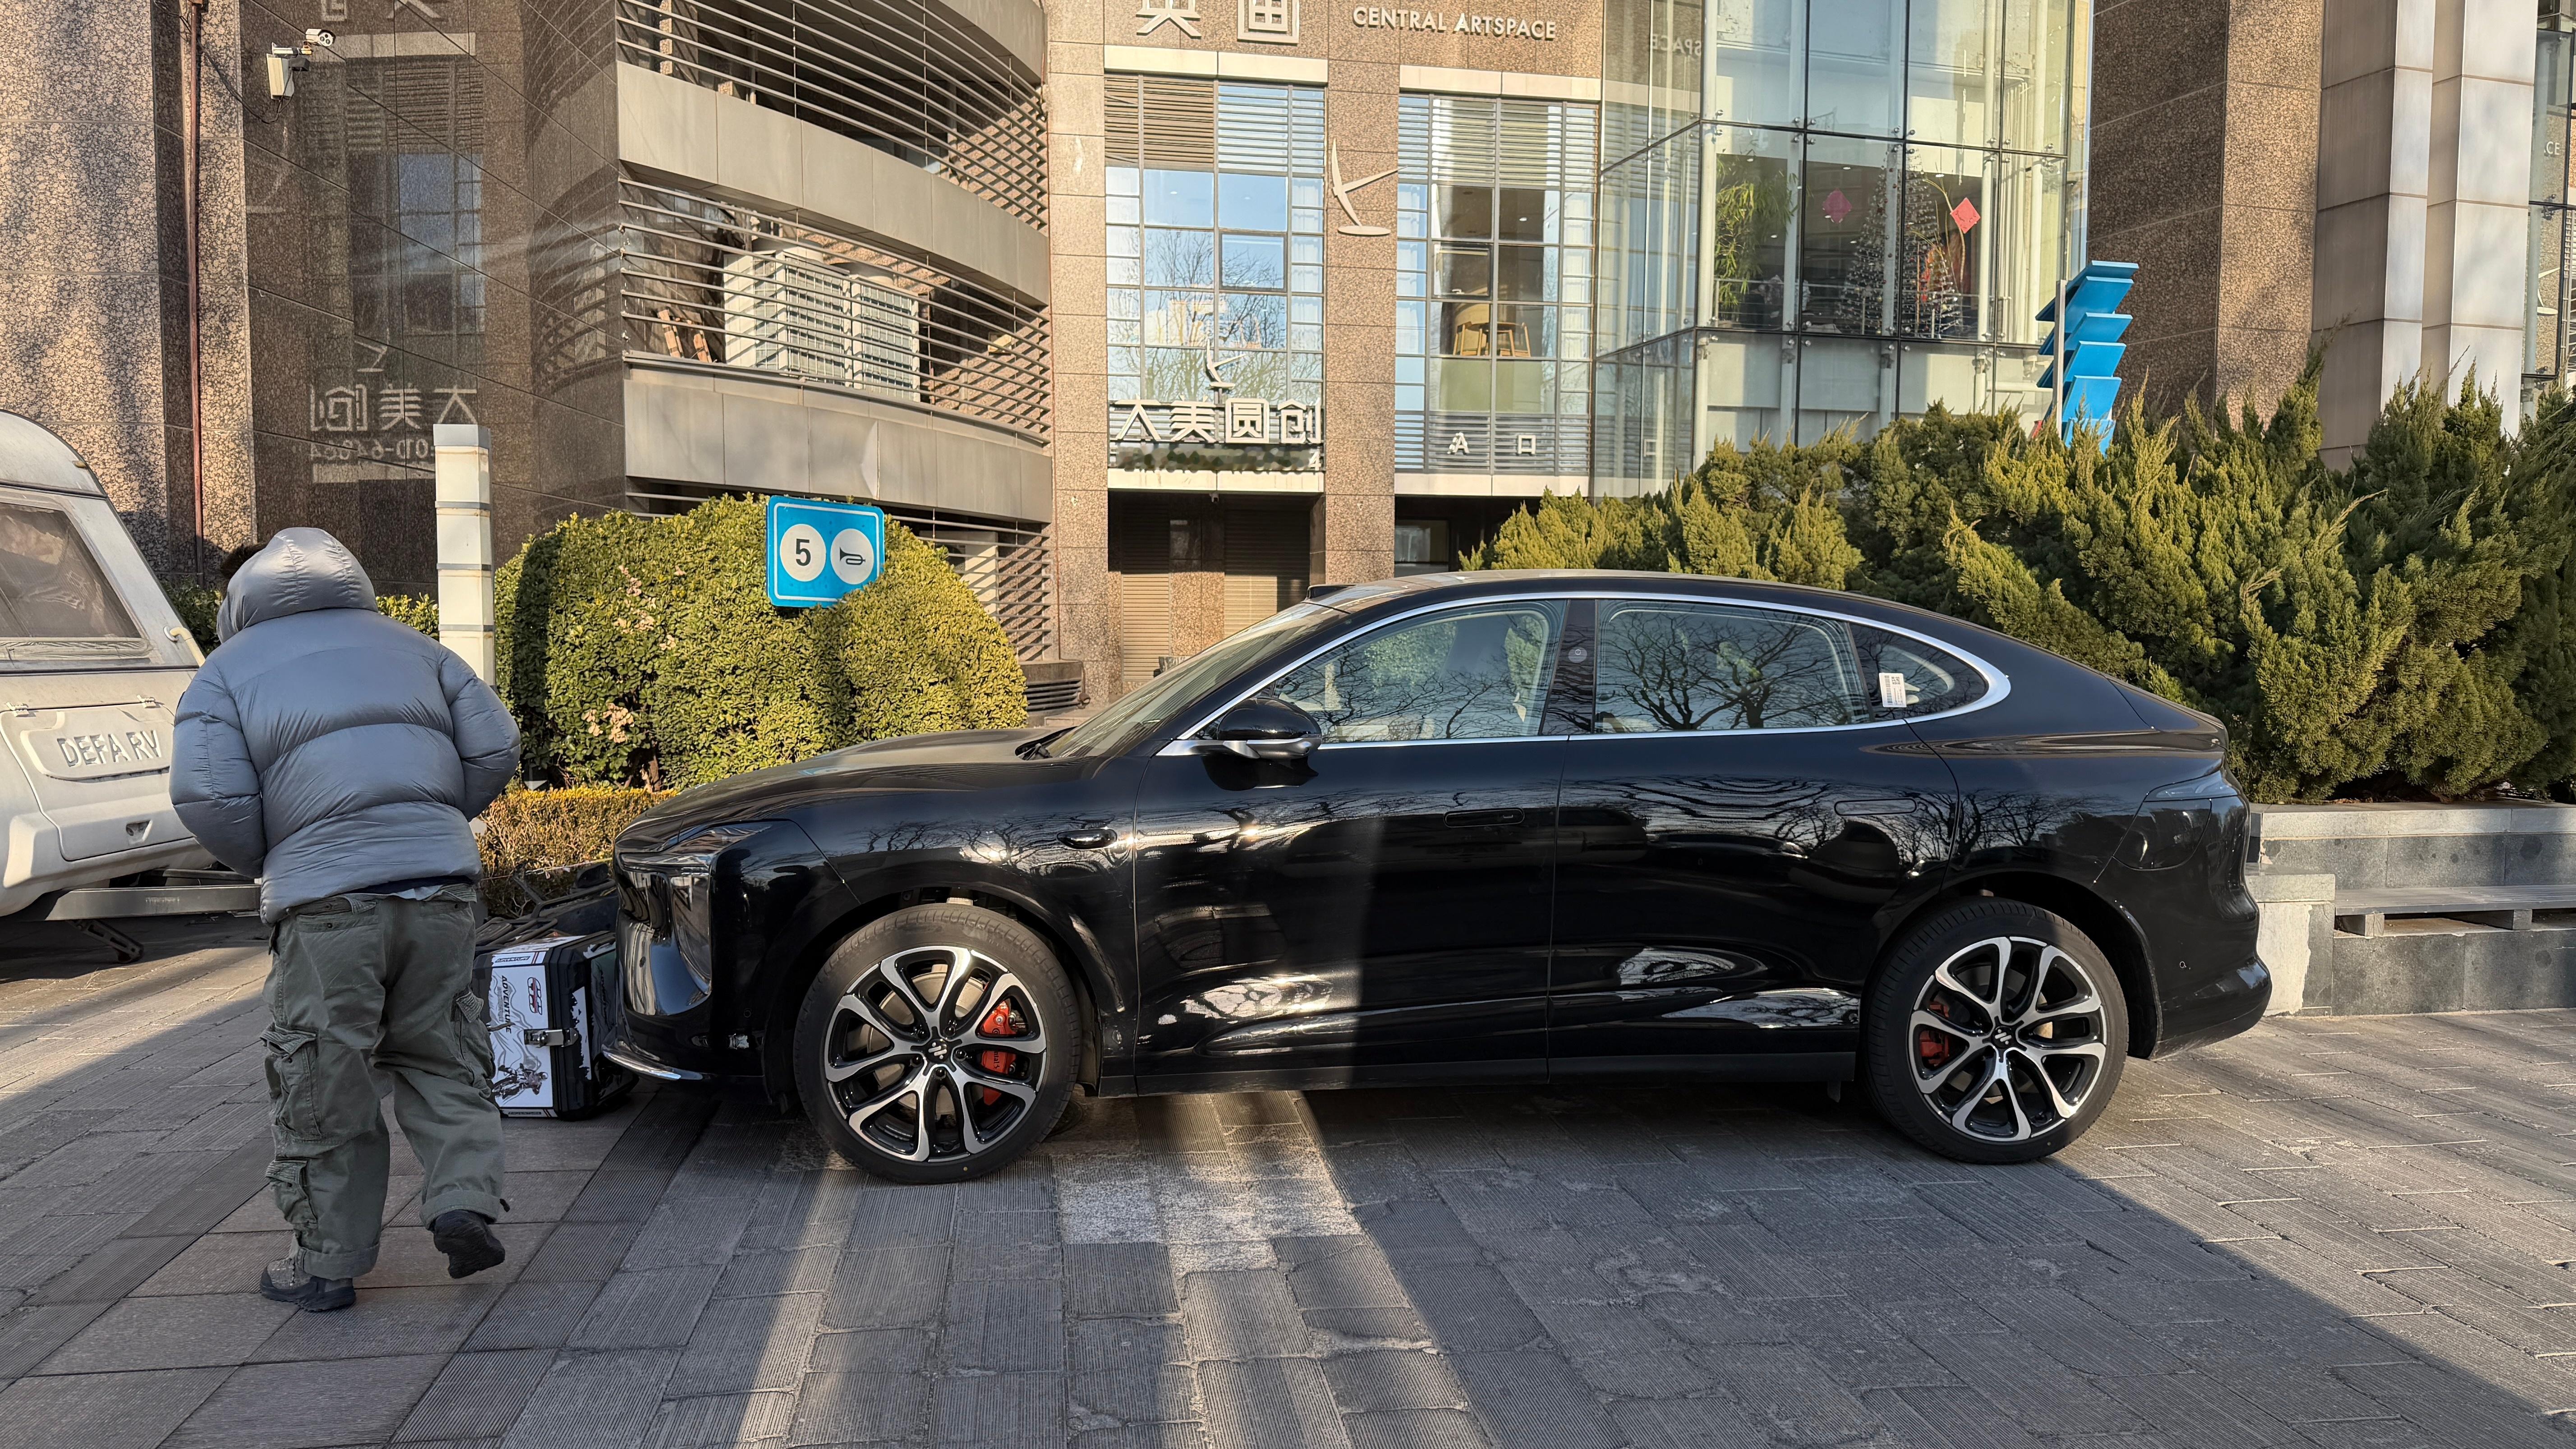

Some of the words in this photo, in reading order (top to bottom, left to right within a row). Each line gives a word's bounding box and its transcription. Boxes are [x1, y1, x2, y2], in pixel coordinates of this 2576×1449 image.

[1353, 7, 1447, 32] CENTRAL
[1453, 13, 1556, 41] ARTSPACE
[2544, 141, 2561, 155] CE
[1115, 394, 1321, 443] 大美圆创
[796, 538, 811, 566] 5
[57, 733, 132, 767] DEFA
[126, 730, 161, 761] RV
